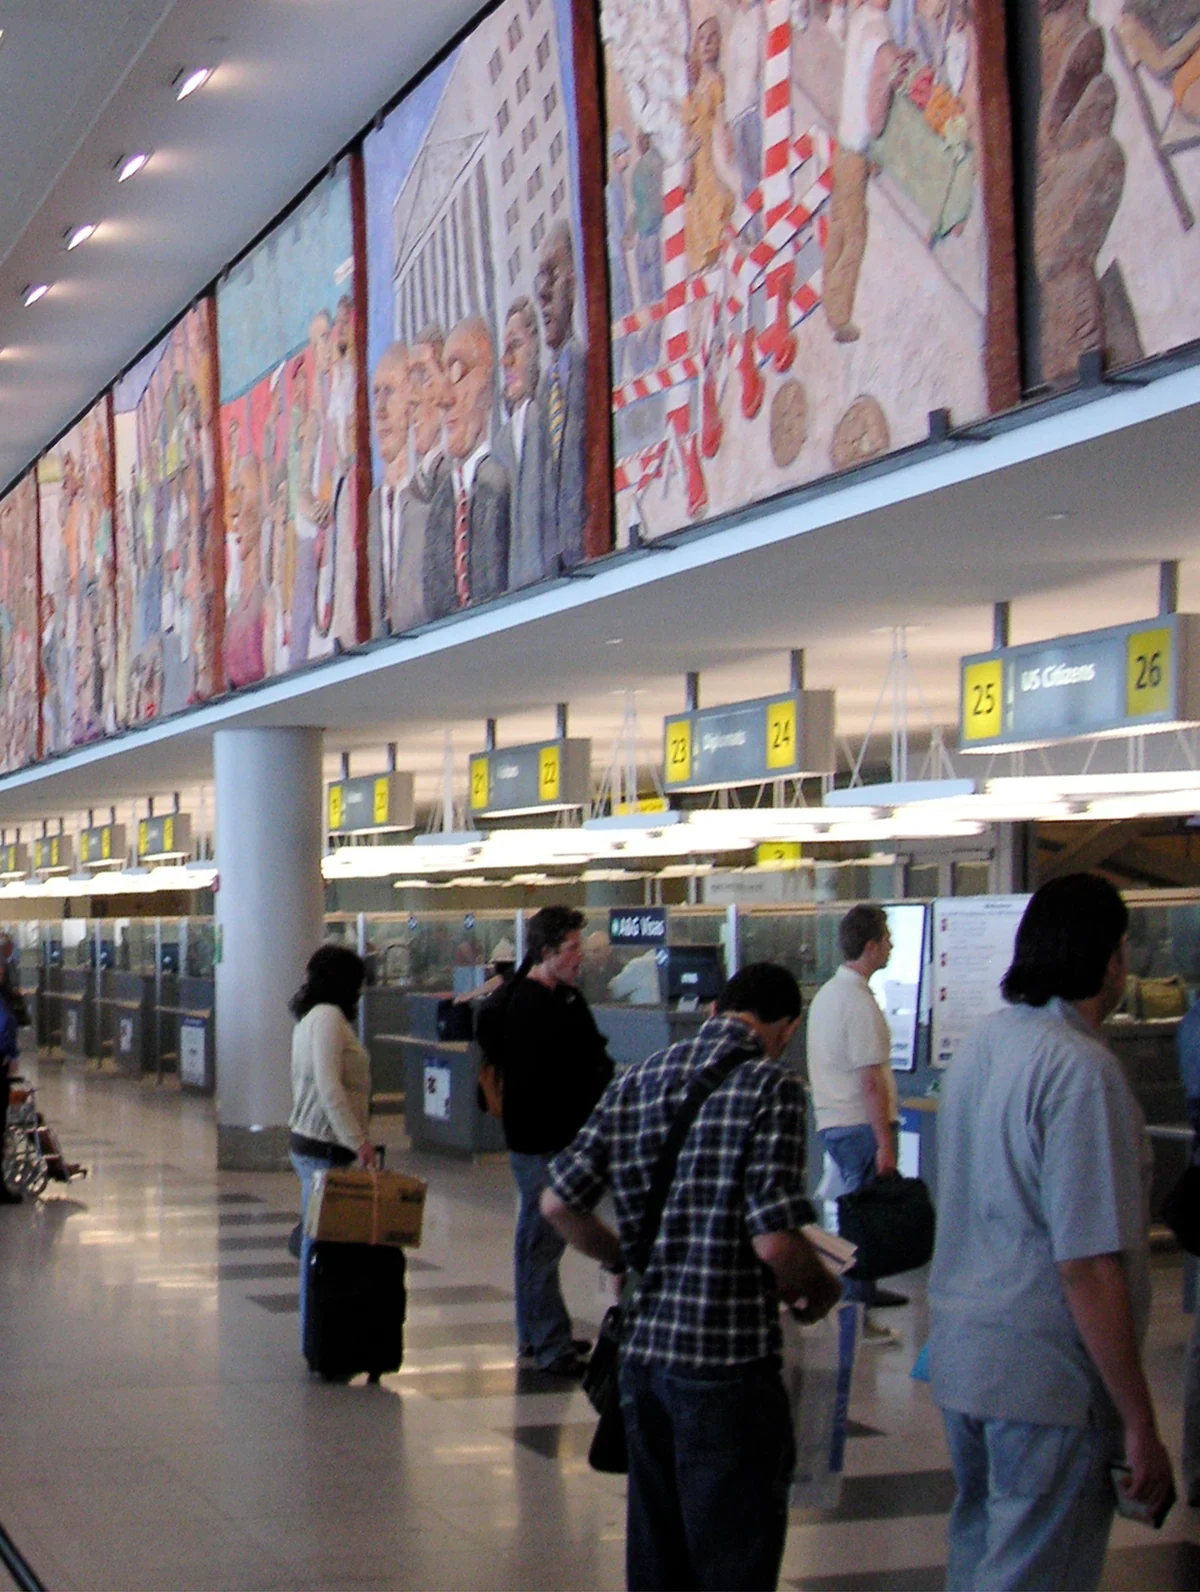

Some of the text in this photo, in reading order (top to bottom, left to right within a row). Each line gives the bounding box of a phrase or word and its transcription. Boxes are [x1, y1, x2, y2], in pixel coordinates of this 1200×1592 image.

[1020, 668, 1041, 692] US
[1135, 652, 1161, 690] 26
[973, 682, 996, 716] 25
[772, 719, 790, 748] 24
[671, 737, 688, 764] 23
